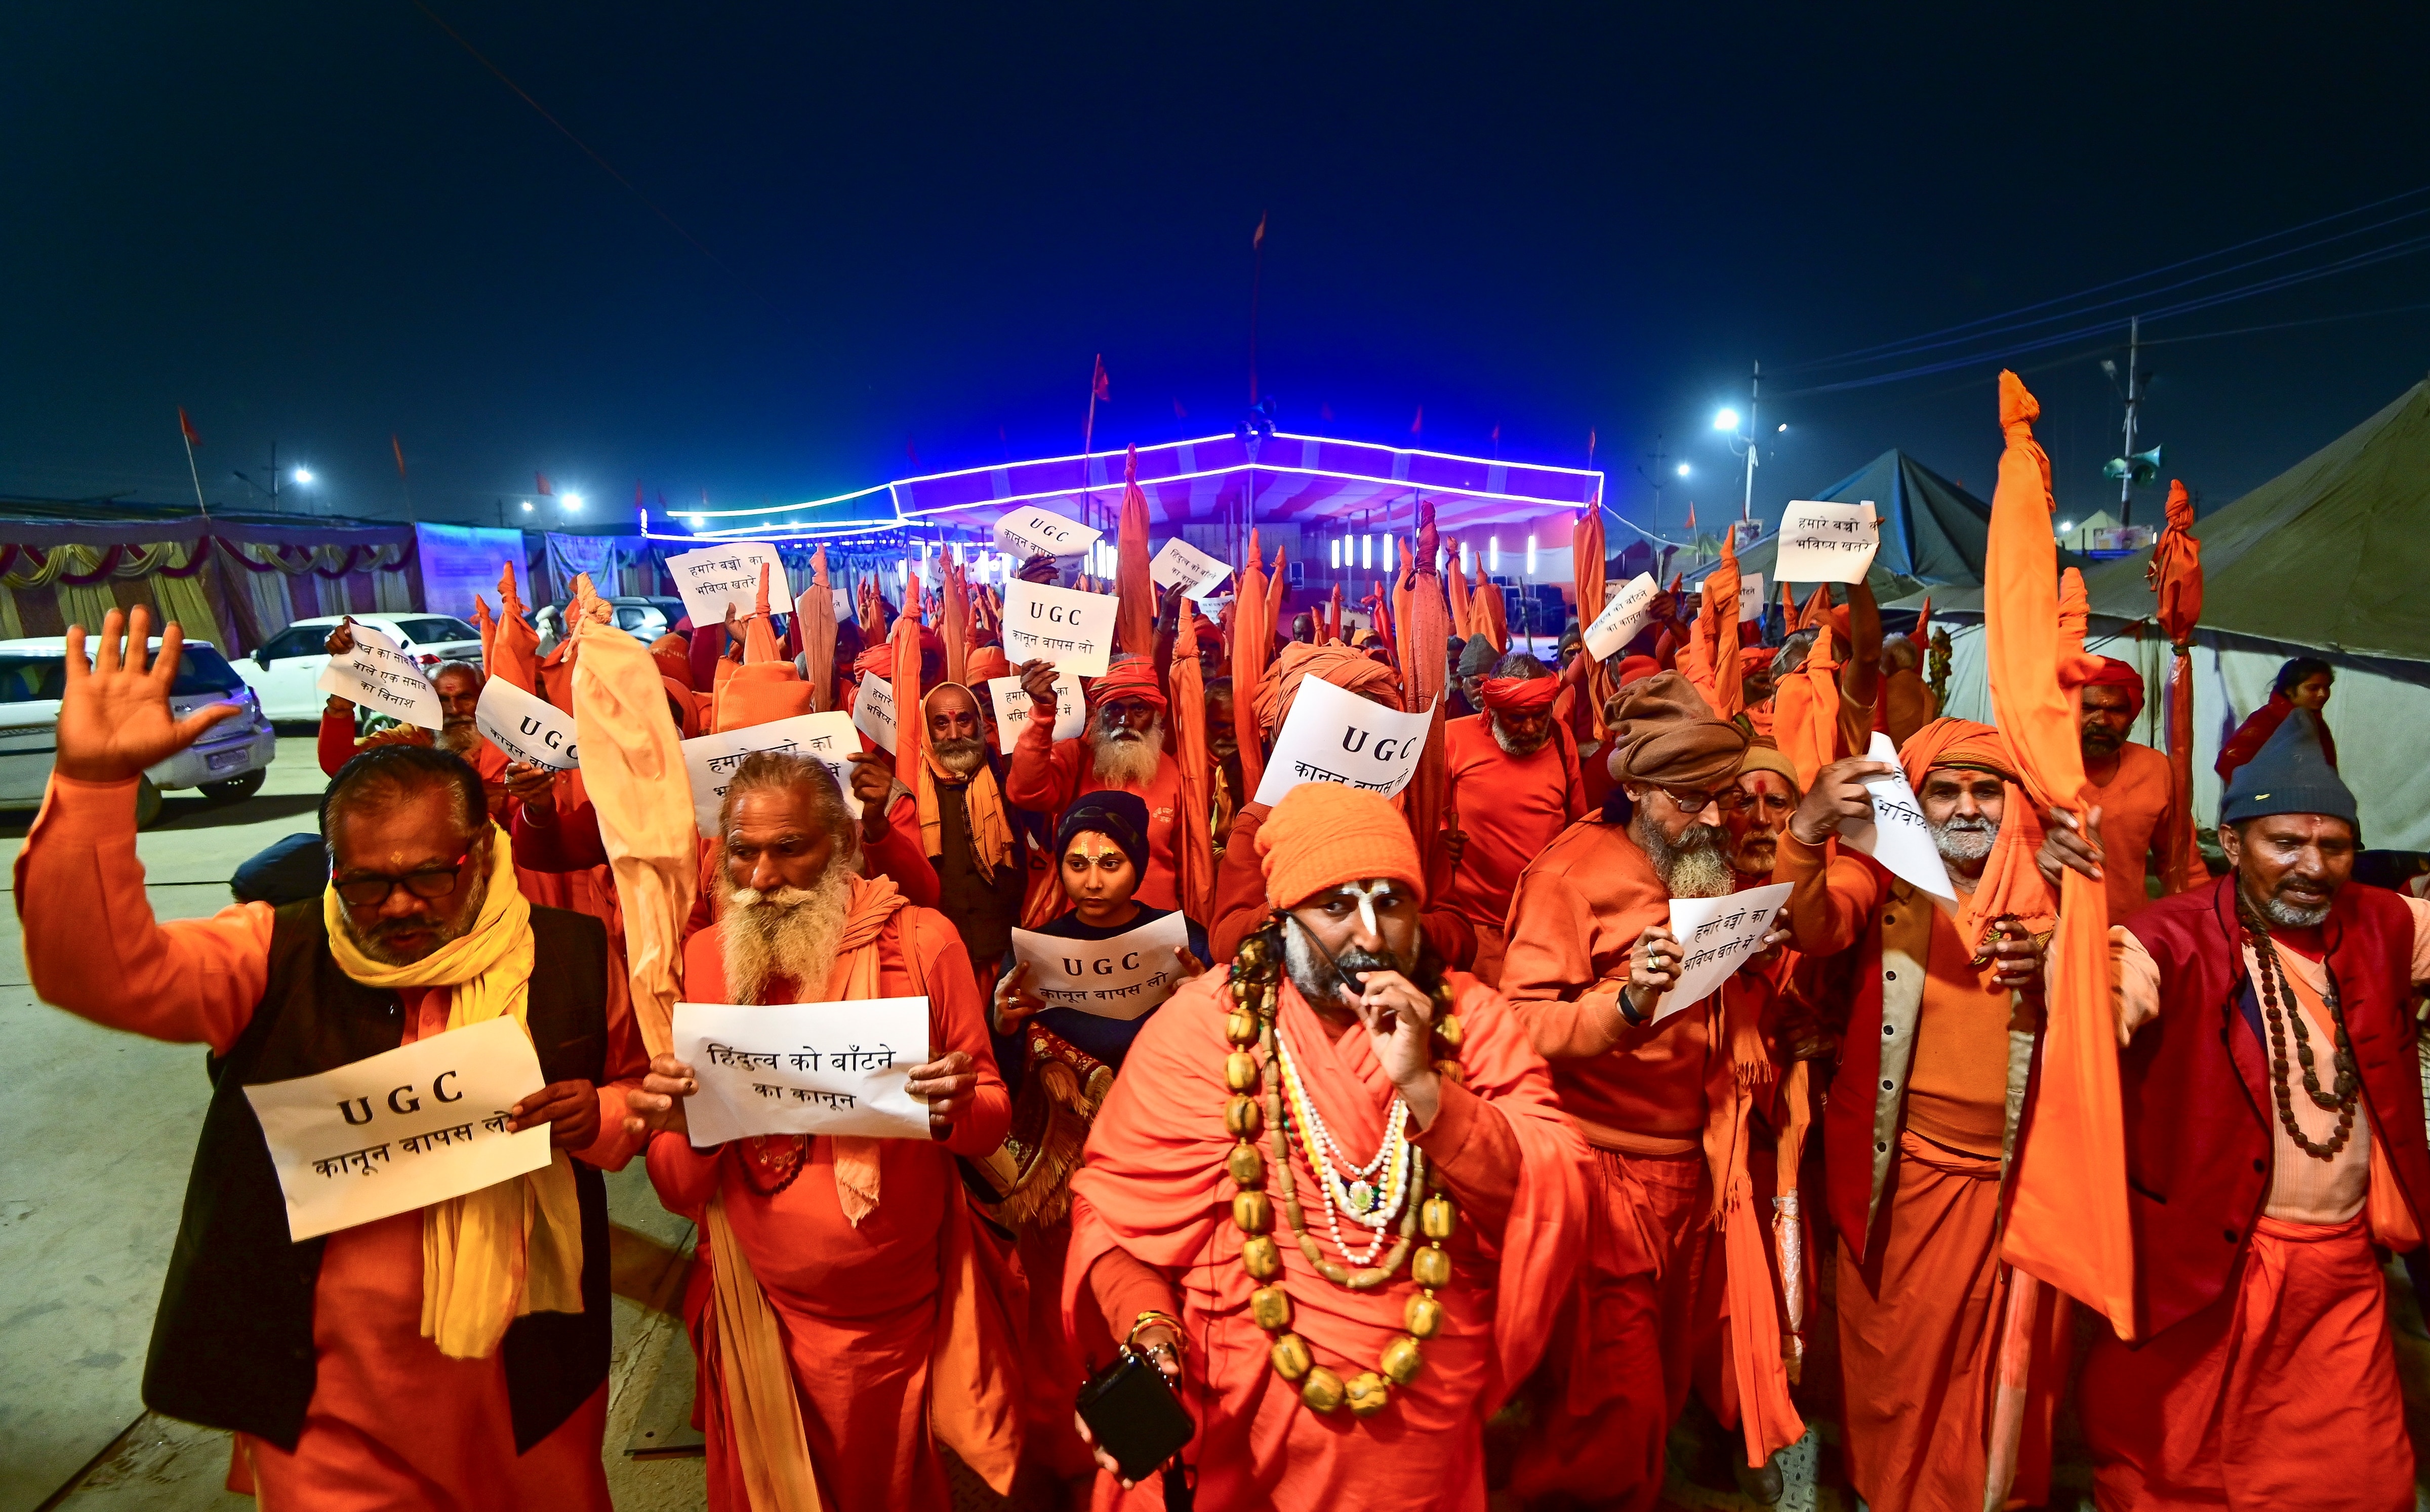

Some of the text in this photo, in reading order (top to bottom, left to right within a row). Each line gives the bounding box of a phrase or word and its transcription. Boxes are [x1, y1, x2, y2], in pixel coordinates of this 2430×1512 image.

[1030, 518, 1069, 542] UGC
[1799, 516, 1829, 531] हमारे
[1004, 528, 1028, 548] कानून
[1796, 537, 1872, 552] भविष्य खतरे
[688, 560, 717, 578] हमारे
[748, 556, 763, 565] का
[696, 575, 757, 595] भविष्य खतरे
[1031, 601, 1081, 626] UGC
[377, 648, 391, 660] का
[1012, 630, 1095, 655] कानून वापस लो
[353, 660, 427, 692] वाले एक समाज
[361, 680, 416, 709] का विनाश
[872, 688, 893, 707] हमारे
[1056, 687, 1068, 696] का
[867, 704, 892, 724] भविष्य
[1063, 704, 1072, 716] में
[490, 727, 526, 758] कानून
[809, 735, 833, 752] का
[1342, 725, 1418, 761] UGC
[1694, 915, 1724, 943] हमारे
[1752, 909, 1769, 924] का
[1062, 952, 1140, 977] UGC
[1684, 934, 1756, 972] भविष्य खतरे में
[1039, 971, 1169, 1003] कानून वापस लो
[706, 1043, 896, 1072] हिंदुत्व को बाँटने
[337, 1070, 463, 1126] UGC
[752, 1082, 857, 1112] का कानून
[312, 1142, 391, 1178] कानून
[399, 1122, 473, 1155] वापस
